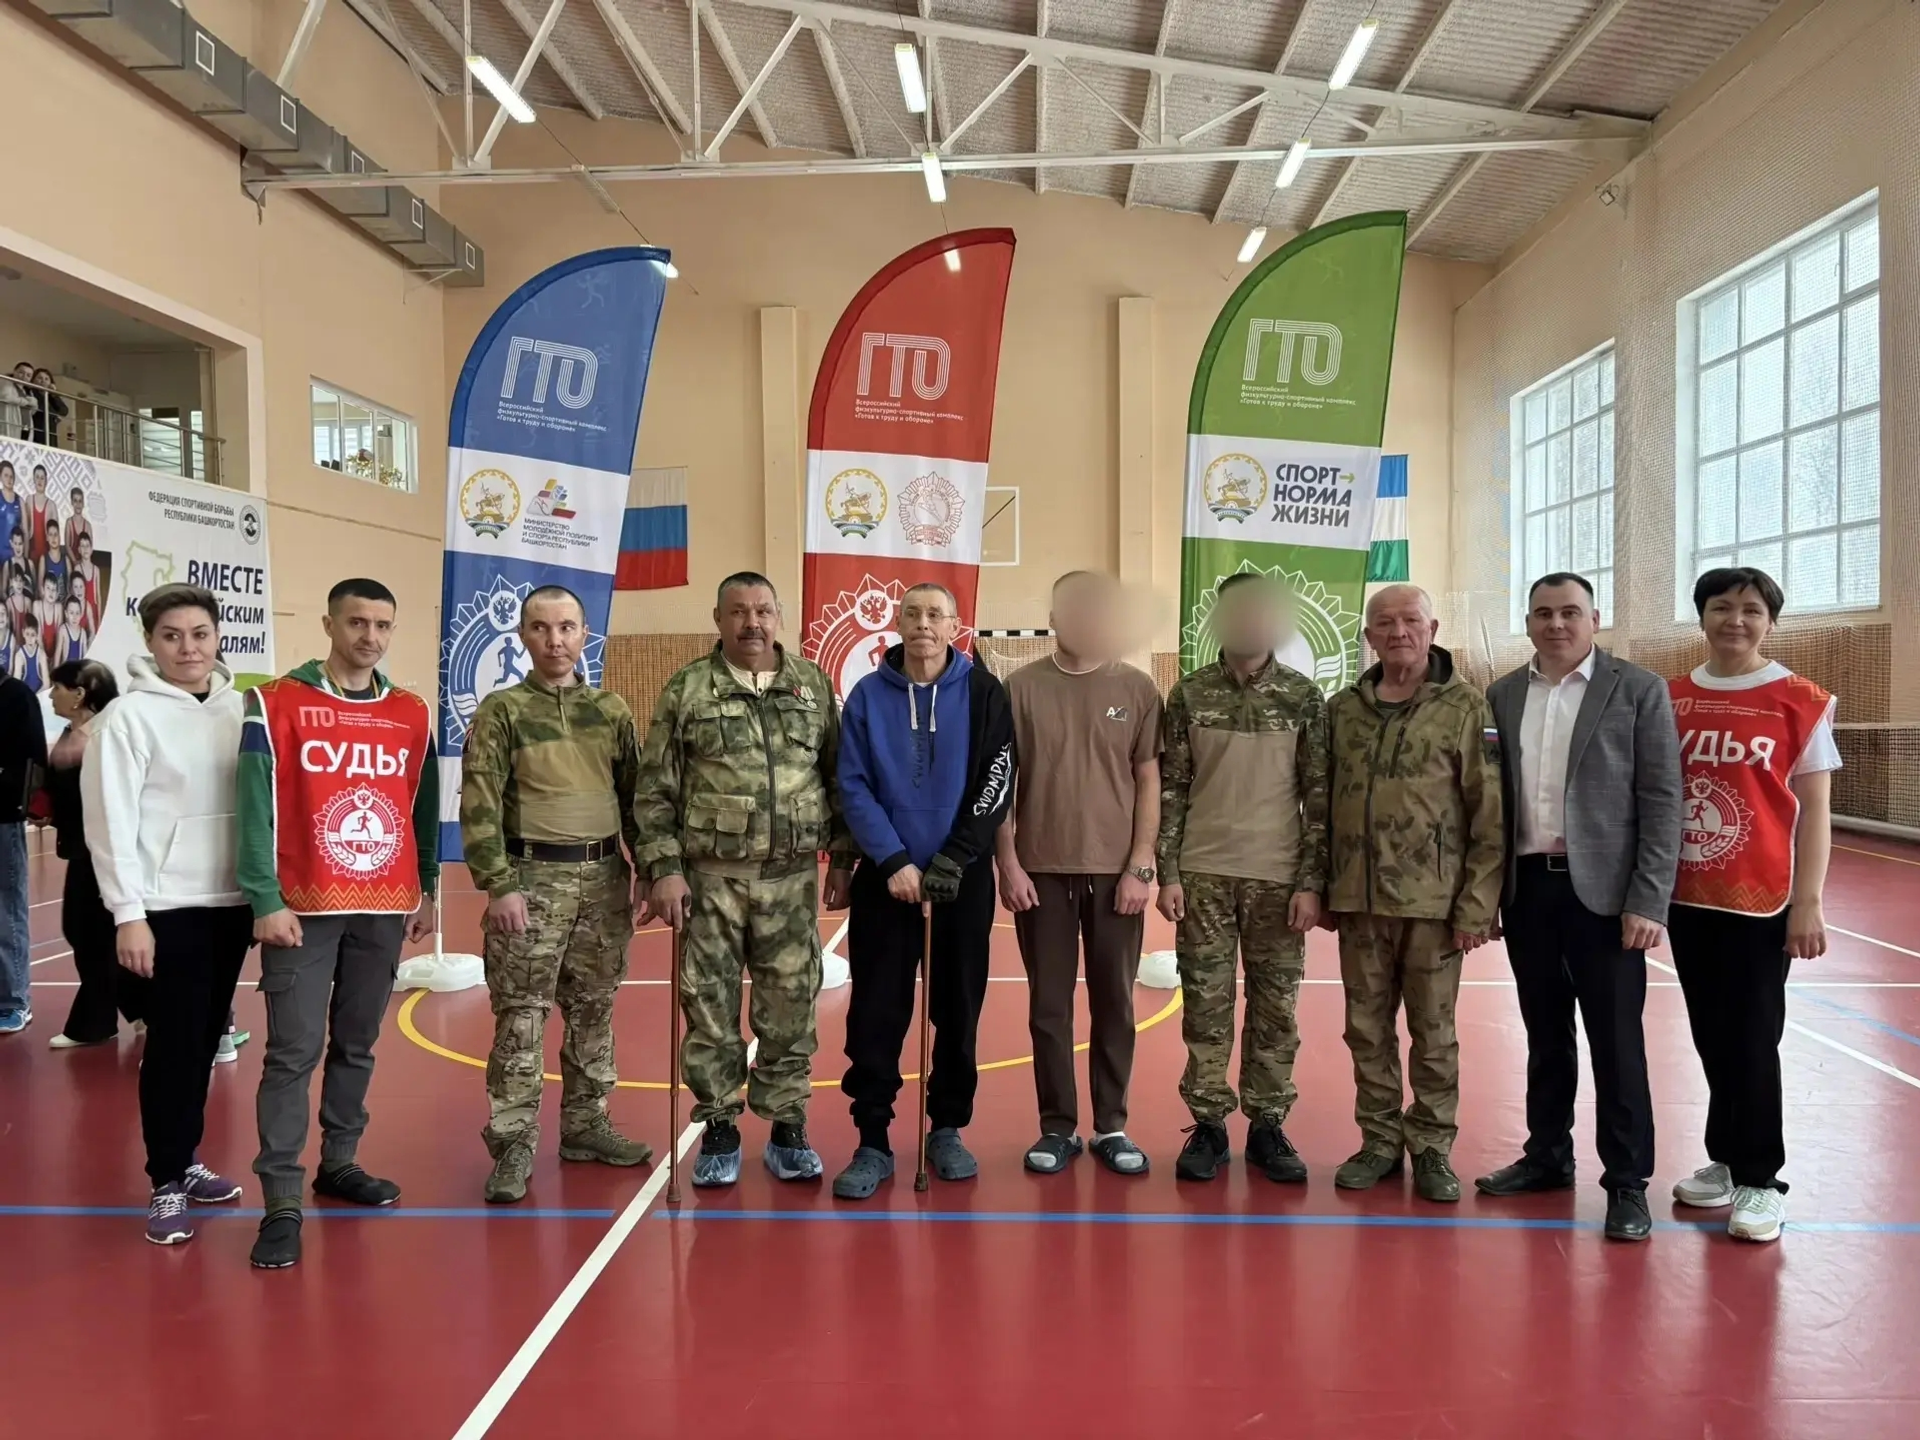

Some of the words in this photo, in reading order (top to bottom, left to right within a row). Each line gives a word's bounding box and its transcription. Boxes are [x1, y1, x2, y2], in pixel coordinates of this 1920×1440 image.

[1243, 318, 1343, 386] ГТО
[501, 336, 598, 409] ГТО
[857, 332, 951, 401] ГТО
[1241, 384, 1289, 393] Всероссийский
[498, 401, 544, 413] Всероссийский
[855, 399, 901, 407] Всероссийский
[1275, 463, 1341, 485] СПОРТ
[181, 497, 214, 512] СПОРТИВНОЙ
[214, 503, 235, 516] БОРЬБЫ
[1273, 484, 1352, 507] НОРМА
[164, 508, 197, 523] РЕСПУБЛИКИ
[198, 514, 236, 530] БАШКОРТОСТАН
[524, 517, 570, 531] МИНИСТЕРСТВО
[1271, 504, 1350, 528] ЖИЗНИ
[521, 537, 568, 550] БАШКОРТОСТАН
[528, 532, 551, 540] СПОРТА
[551, 535, 591, 547] РЕСПУБЛИКИ
[565, 531, 599, 543] ПОЛИТИКИ
[187, 559, 264, 595] ВМЕСТЕ
[219, 631, 266, 654] алям!
[299, 706, 336, 728] ГТО
[1671, 697, 1693, 716] ТО
[300, 740, 410, 779] СУДЬЯ
[1680, 729, 1777, 771] УДЬЯ
[352, 841, 375, 852] ГТО
[1682, 830, 1708, 842] ГТО
